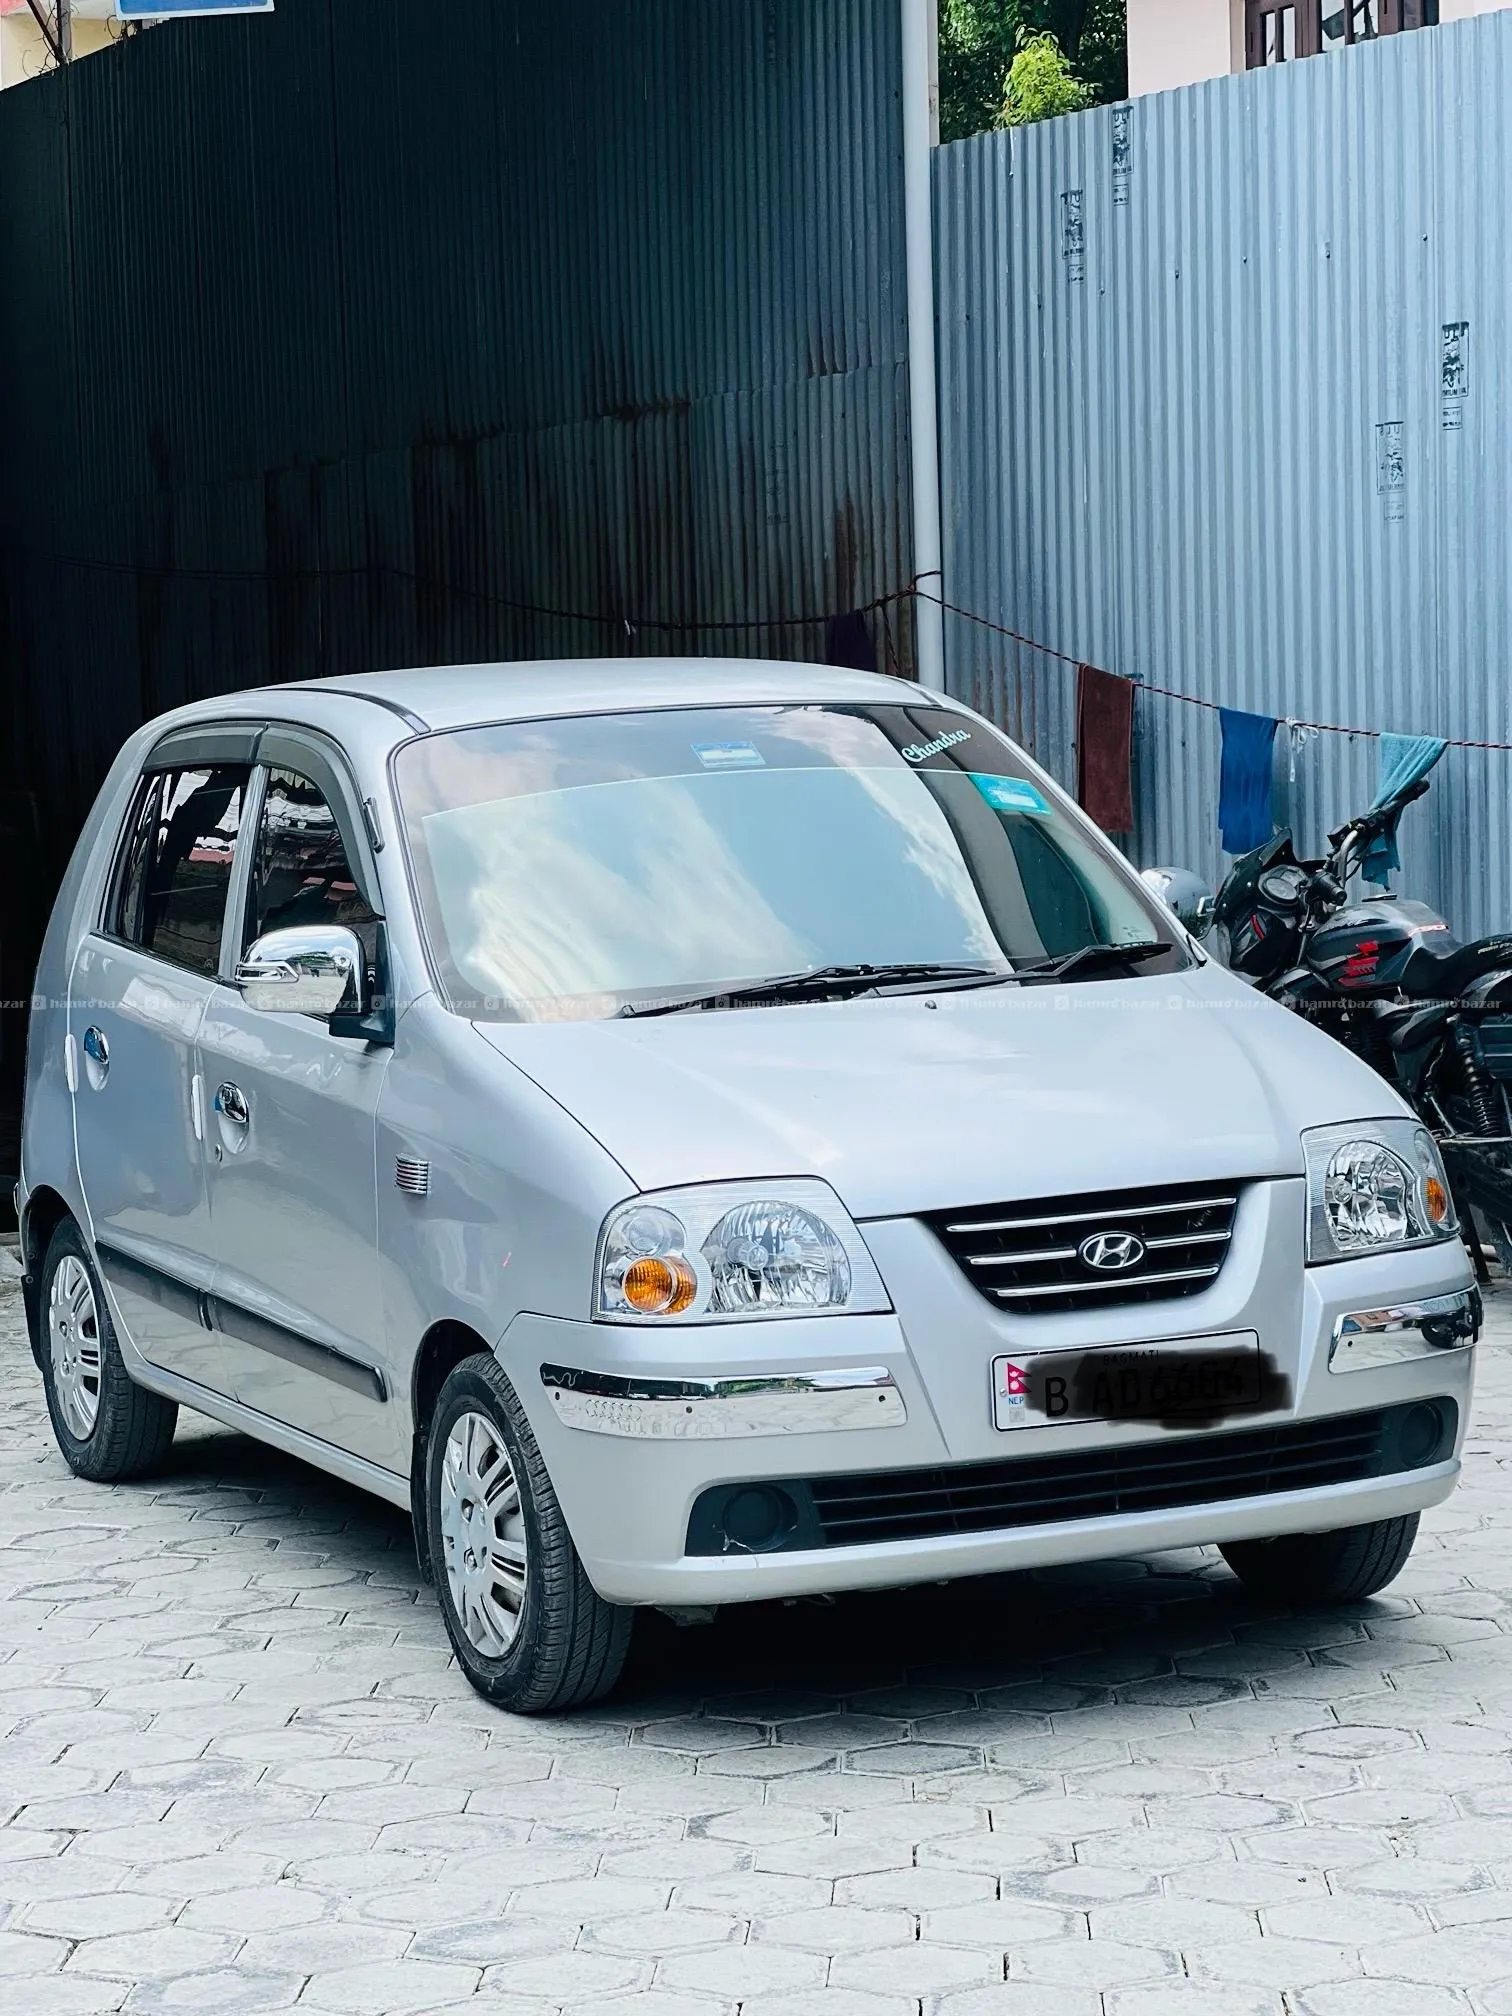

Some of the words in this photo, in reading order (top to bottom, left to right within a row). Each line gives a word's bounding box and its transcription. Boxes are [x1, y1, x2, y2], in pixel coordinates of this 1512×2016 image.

[902, 729, 971, 762] Chandra
[1008, 1396, 1025, 1405] NEP
[1045, 1376, 1069, 1418] B
